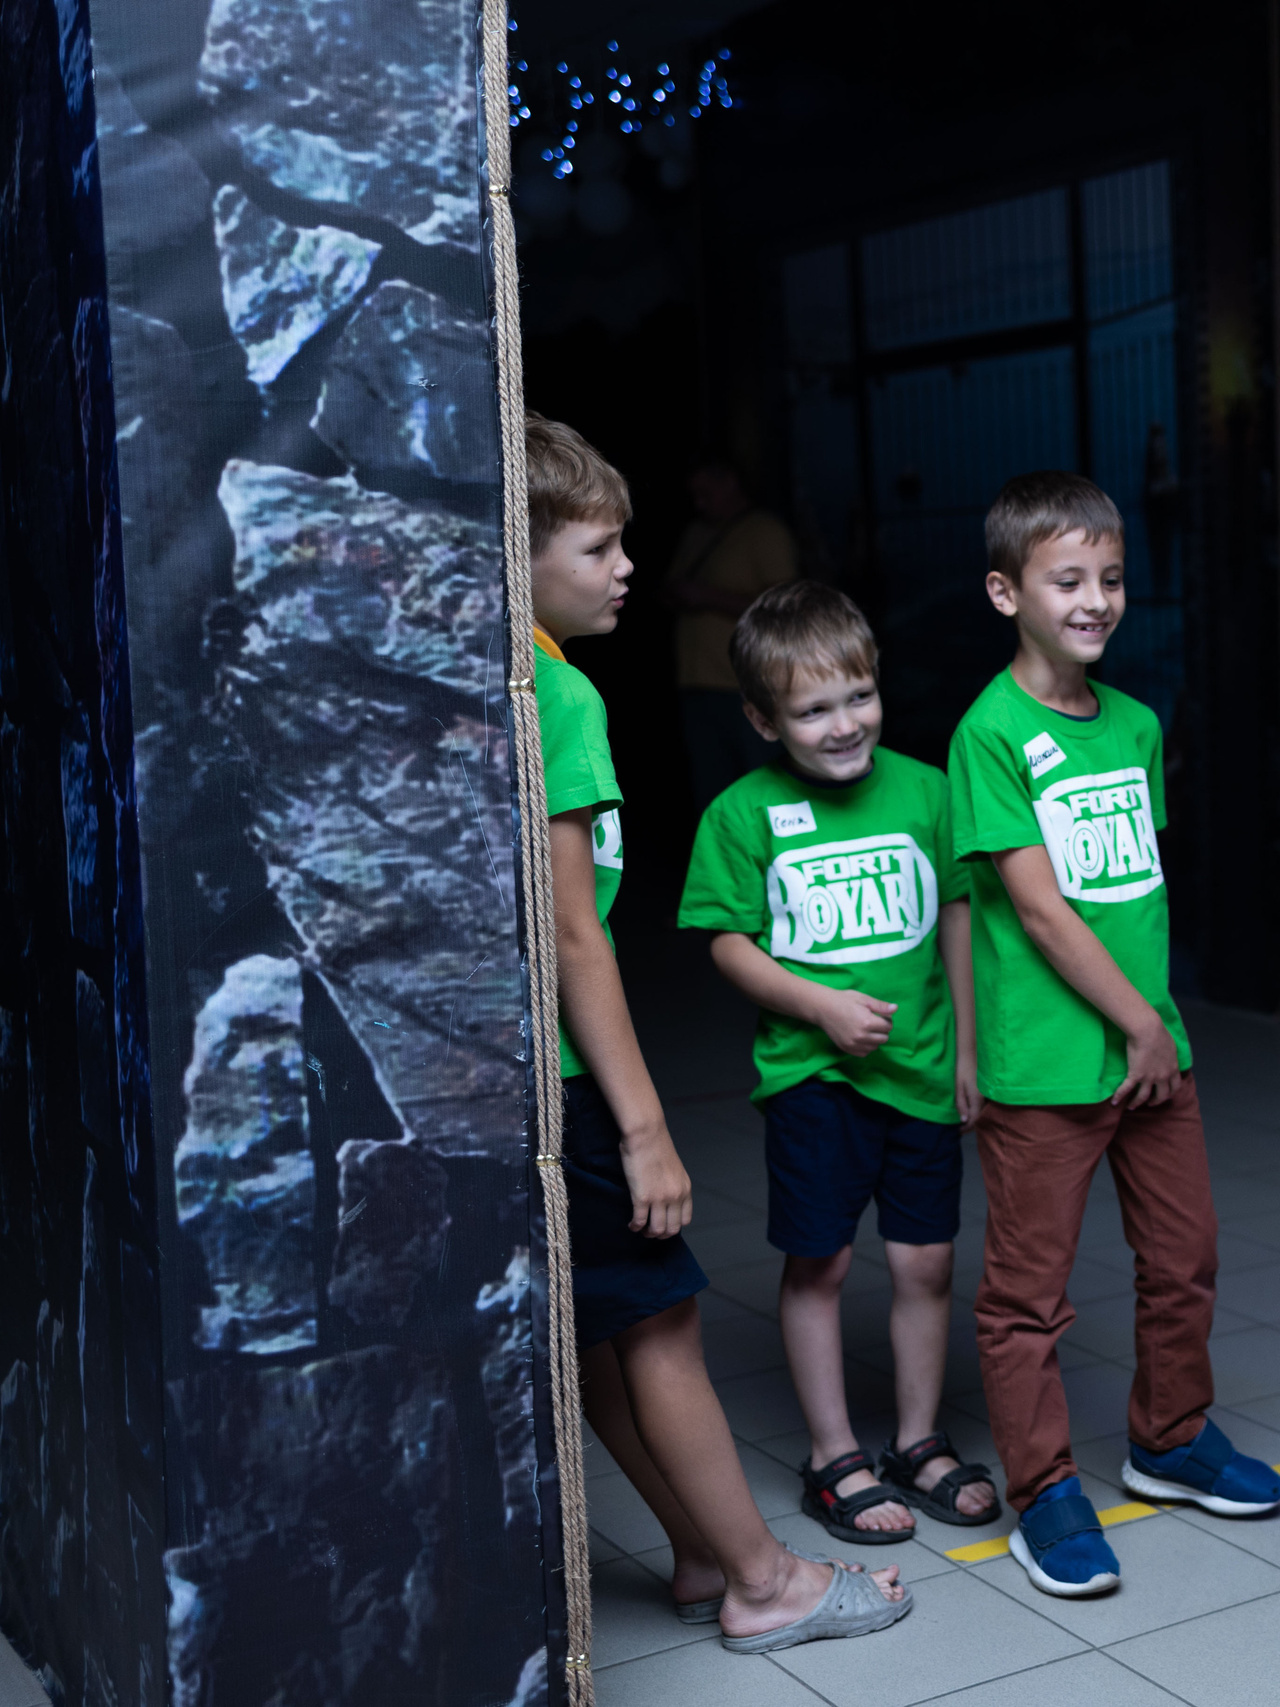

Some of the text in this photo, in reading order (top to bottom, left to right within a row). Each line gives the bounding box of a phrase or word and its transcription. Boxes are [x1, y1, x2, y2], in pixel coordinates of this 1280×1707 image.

[1068, 783, 1138, 818] FORT
[801, 848, 894, 885] FORT
[766, 847, 939, 958] BOYARD
